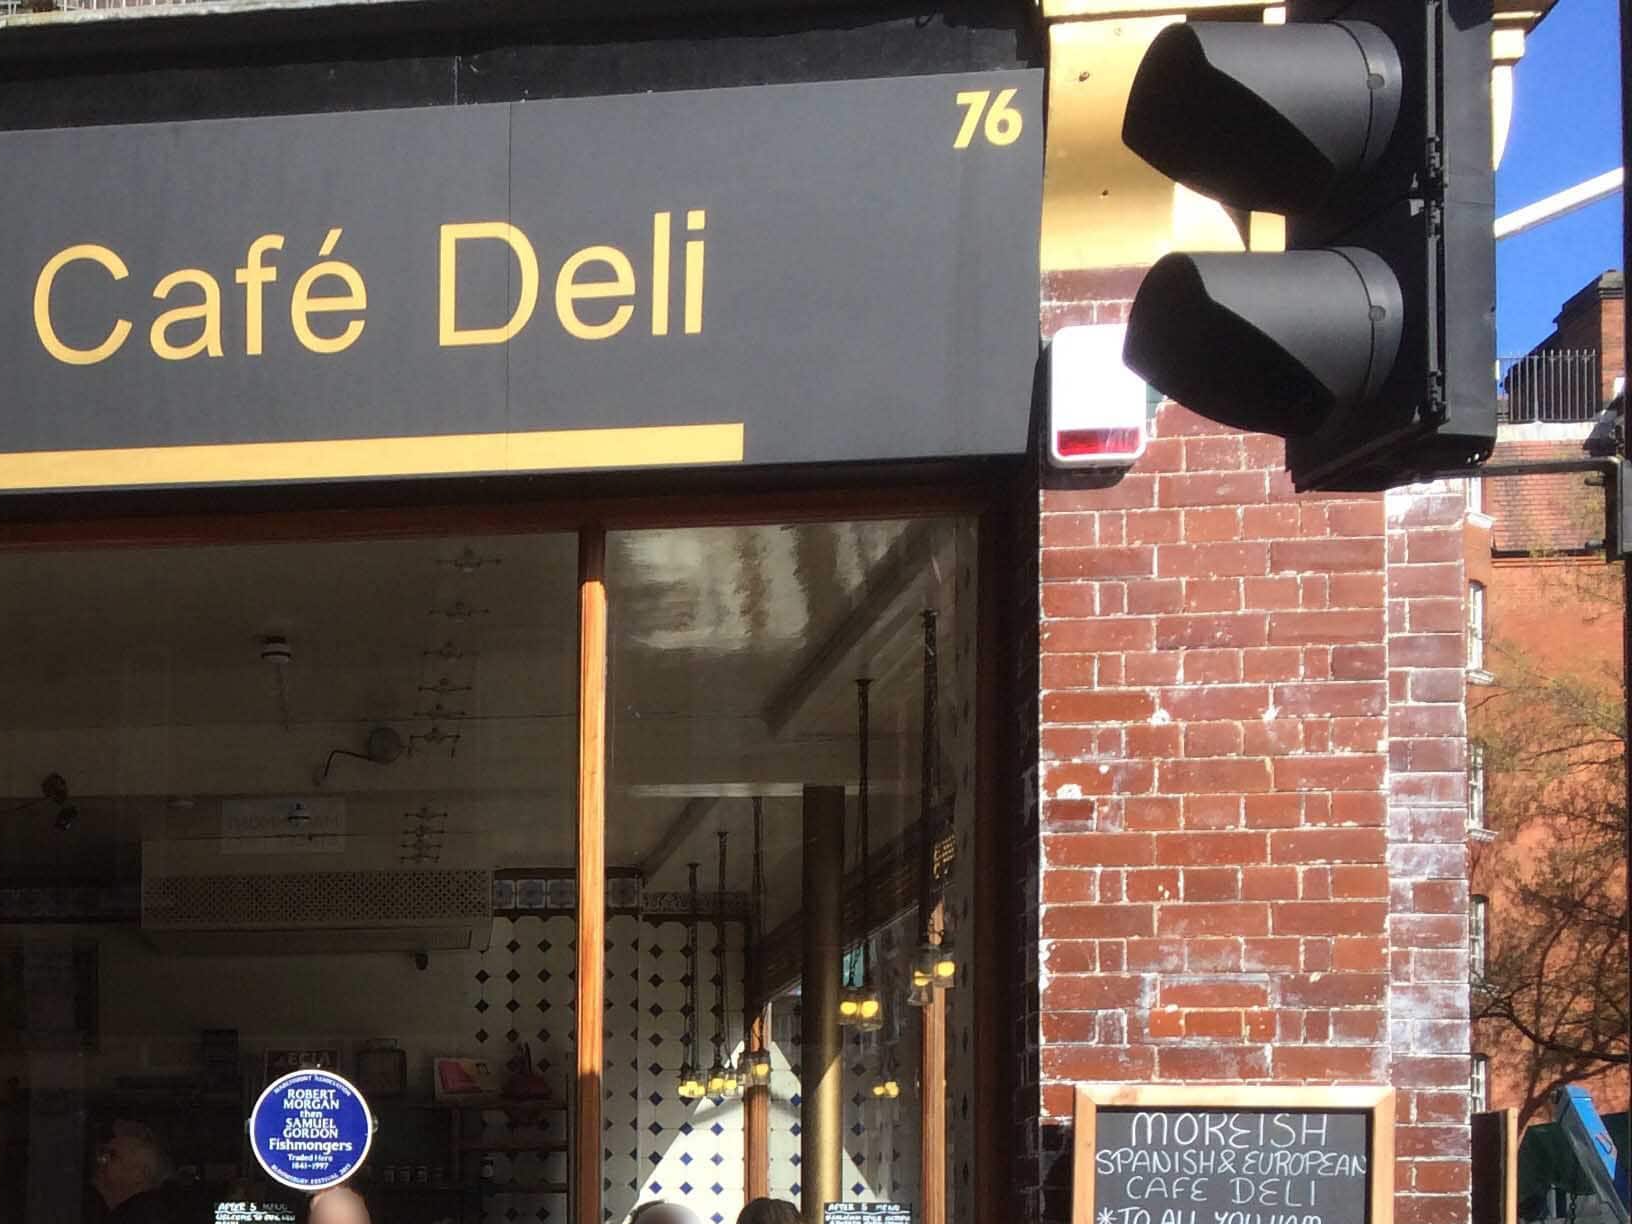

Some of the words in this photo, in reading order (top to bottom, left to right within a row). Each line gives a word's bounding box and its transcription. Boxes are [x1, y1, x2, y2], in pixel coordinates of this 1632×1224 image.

[953, 88, 1023, 149] 76
[34, 228, 368, 366] Café
[439, 210, 706, 347] Deli
[283, 1099, 339, 1109] MORGAN
[288, 1089, 336, 1099] ROBERT
[283, 1128, 338, 1138] GORDON
[285, 1118, 336, 1128] SAMUEL
[1132, 1111, 1328, 1148] MOREISH
[269, 1138, 353, 1154] Fishmongers
[1096, 1148, 1214, 1175] SPANISH
[1217, 1149, 1236, 1174] &
[1242, 1151, 1367, 1176] EUROPEAN
[1126, 1176, 1209, 1201] CAFE
[1230, 1178, 1317, 1207] DELI
